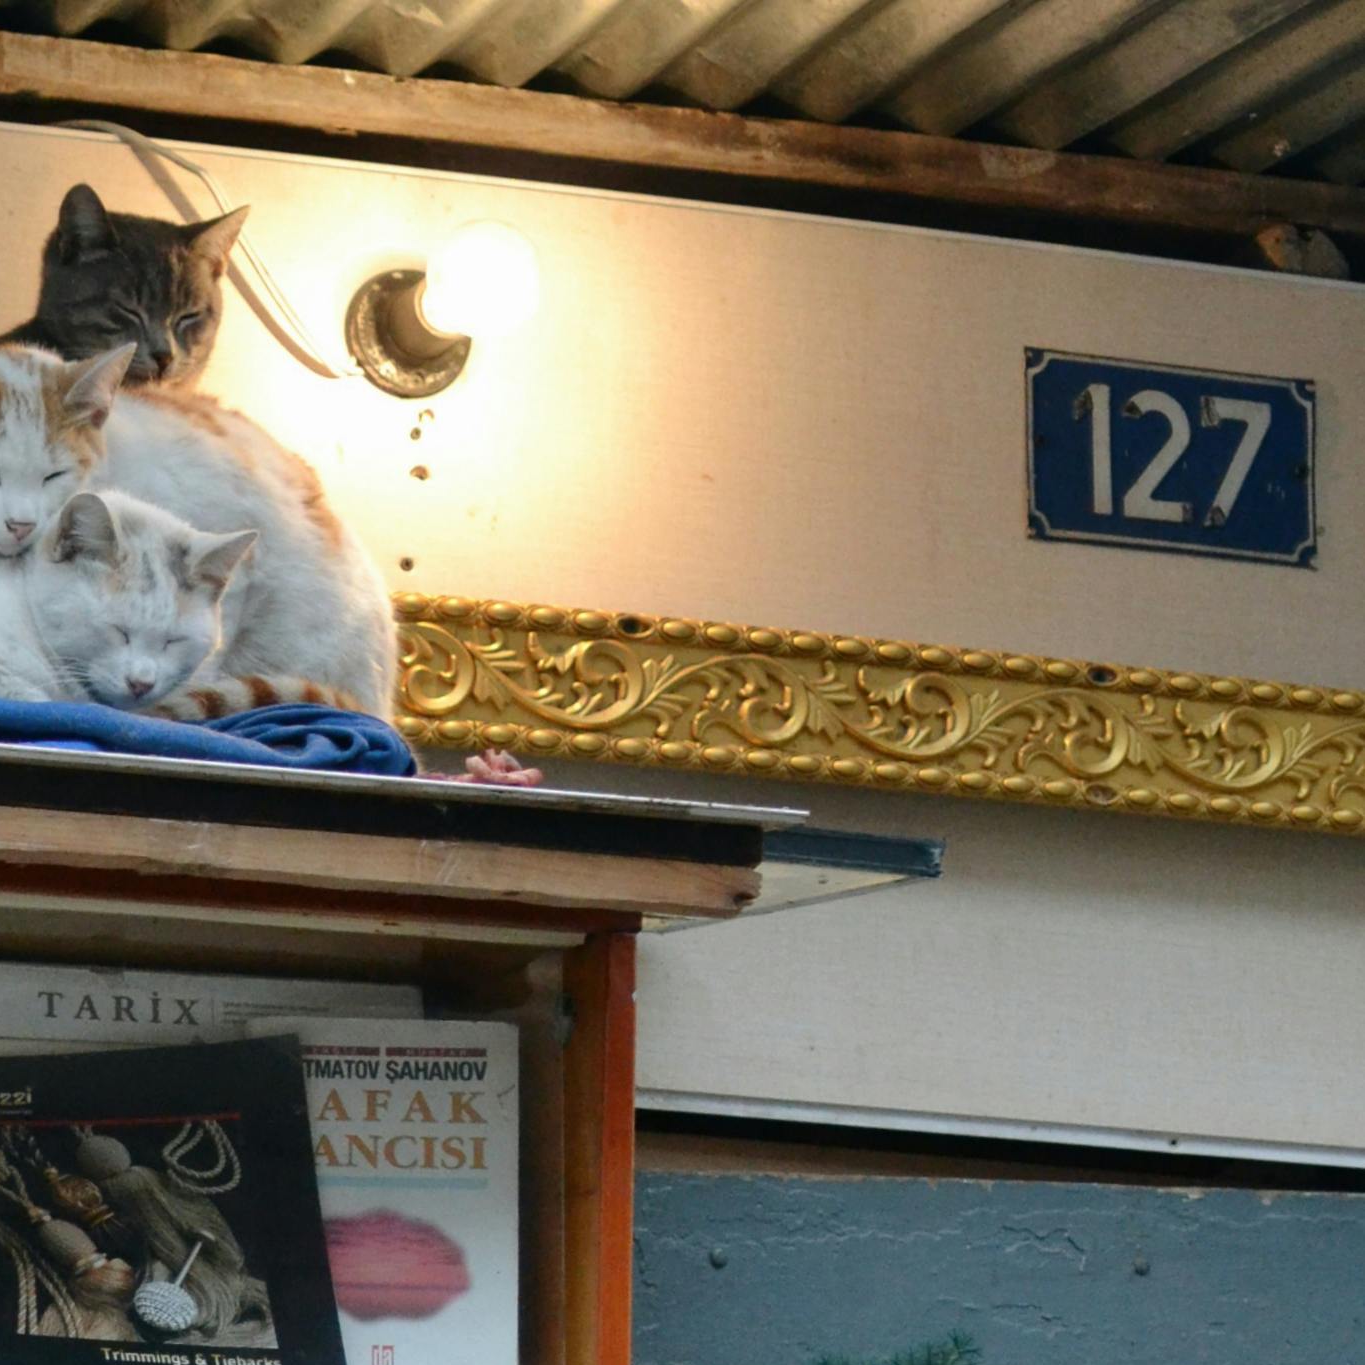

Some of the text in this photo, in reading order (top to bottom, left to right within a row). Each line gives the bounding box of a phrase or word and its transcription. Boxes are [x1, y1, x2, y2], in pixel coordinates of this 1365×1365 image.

[1073, 383, 1271, 527] 127
[37, 990, 200, 1026] TARİX
[385, 1060, 488, 1084] ŞAHANOV
